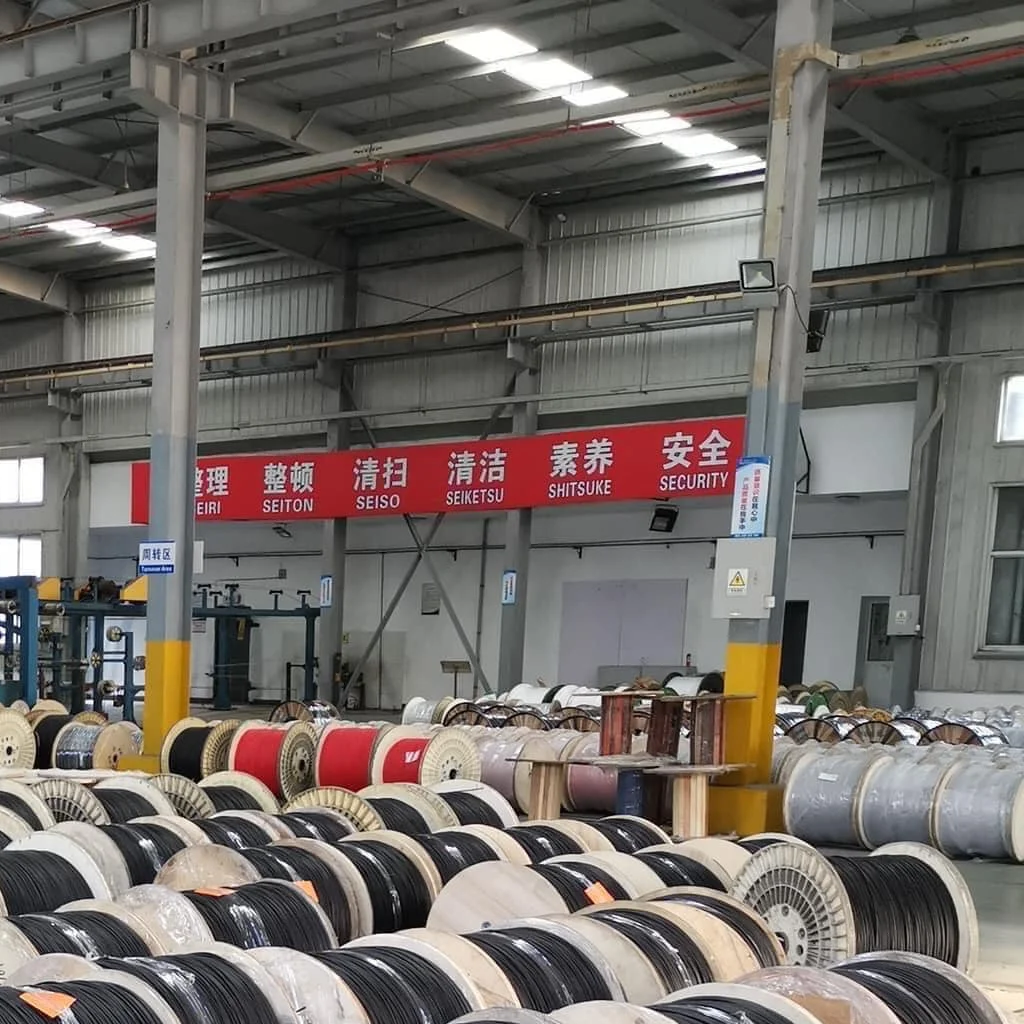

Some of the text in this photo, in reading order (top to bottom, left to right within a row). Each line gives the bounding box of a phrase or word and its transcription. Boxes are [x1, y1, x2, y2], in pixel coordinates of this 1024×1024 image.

[264, 462, 314, 494] 整顿
[353, 457, 408, 491] 清扫
[447, 448, 507, 485] 清洁
[549, 437, 614, 478] 素养
[662, 429, 731, 469] 安全
[196, 472, 728, 515] EIRI SEITON SEISO SEIKETSU SHITSUKE SECURITY
[143, 547, 171, 561] 周转区
